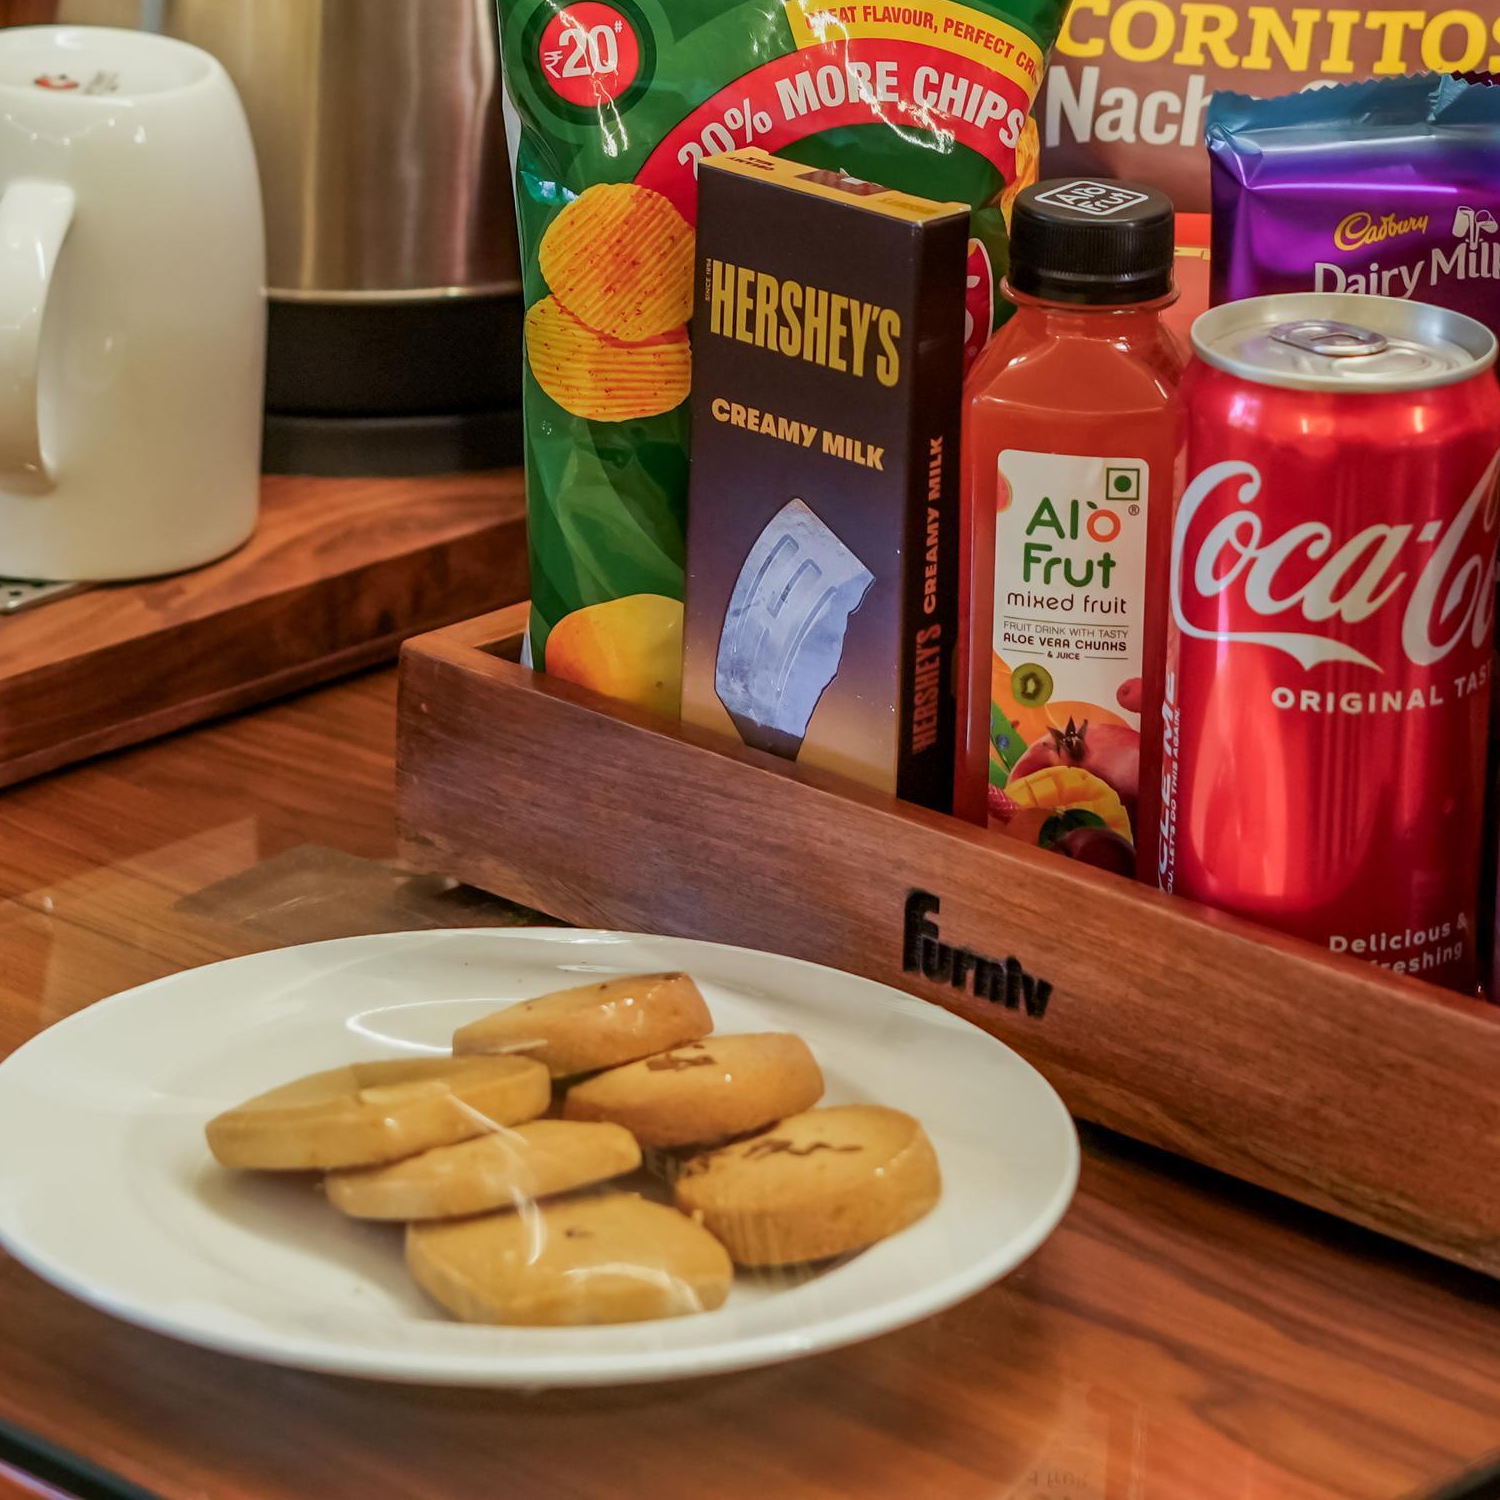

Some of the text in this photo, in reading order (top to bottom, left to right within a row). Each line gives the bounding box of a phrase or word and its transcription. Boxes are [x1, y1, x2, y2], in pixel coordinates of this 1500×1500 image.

[862, 5, 939, 34] FLAVOUR,
[943, 17, 1015, 59] PERFECT
[775, 61, 900, 122] MORE
[912, 65, 1025, 150] CHIPS
[1043, 64, 1209, 148] Nach
[1333, 211, 1430, 252] Cadbury
[1314, 260, 1426, 300] Dairy
[710, 258, 901, 388] HERSHEY'S
[711, 397, 885, 472] CREAMY MILK
[1023, 542, 1117, 589] Frut
[911, 435, 944, 756] HERSHEY'S CREAMY MILK
[1007, 590, 1127, 614] mixed fruit
[1003, 620, 1129, 639] FRUIT DRINK WITH TASTY
[1003, 632, 1127, 651] ALOE VERA CHUNKS
[1046, 650, 1081, 661] & JUICE
[1161, 671, 1176, 757] ME
[1271, 686, 1445, 715] ORIGINAL
[1171, 760, 1180, 794] THIS
[1328, 912, 1469, 953] Delicious &
